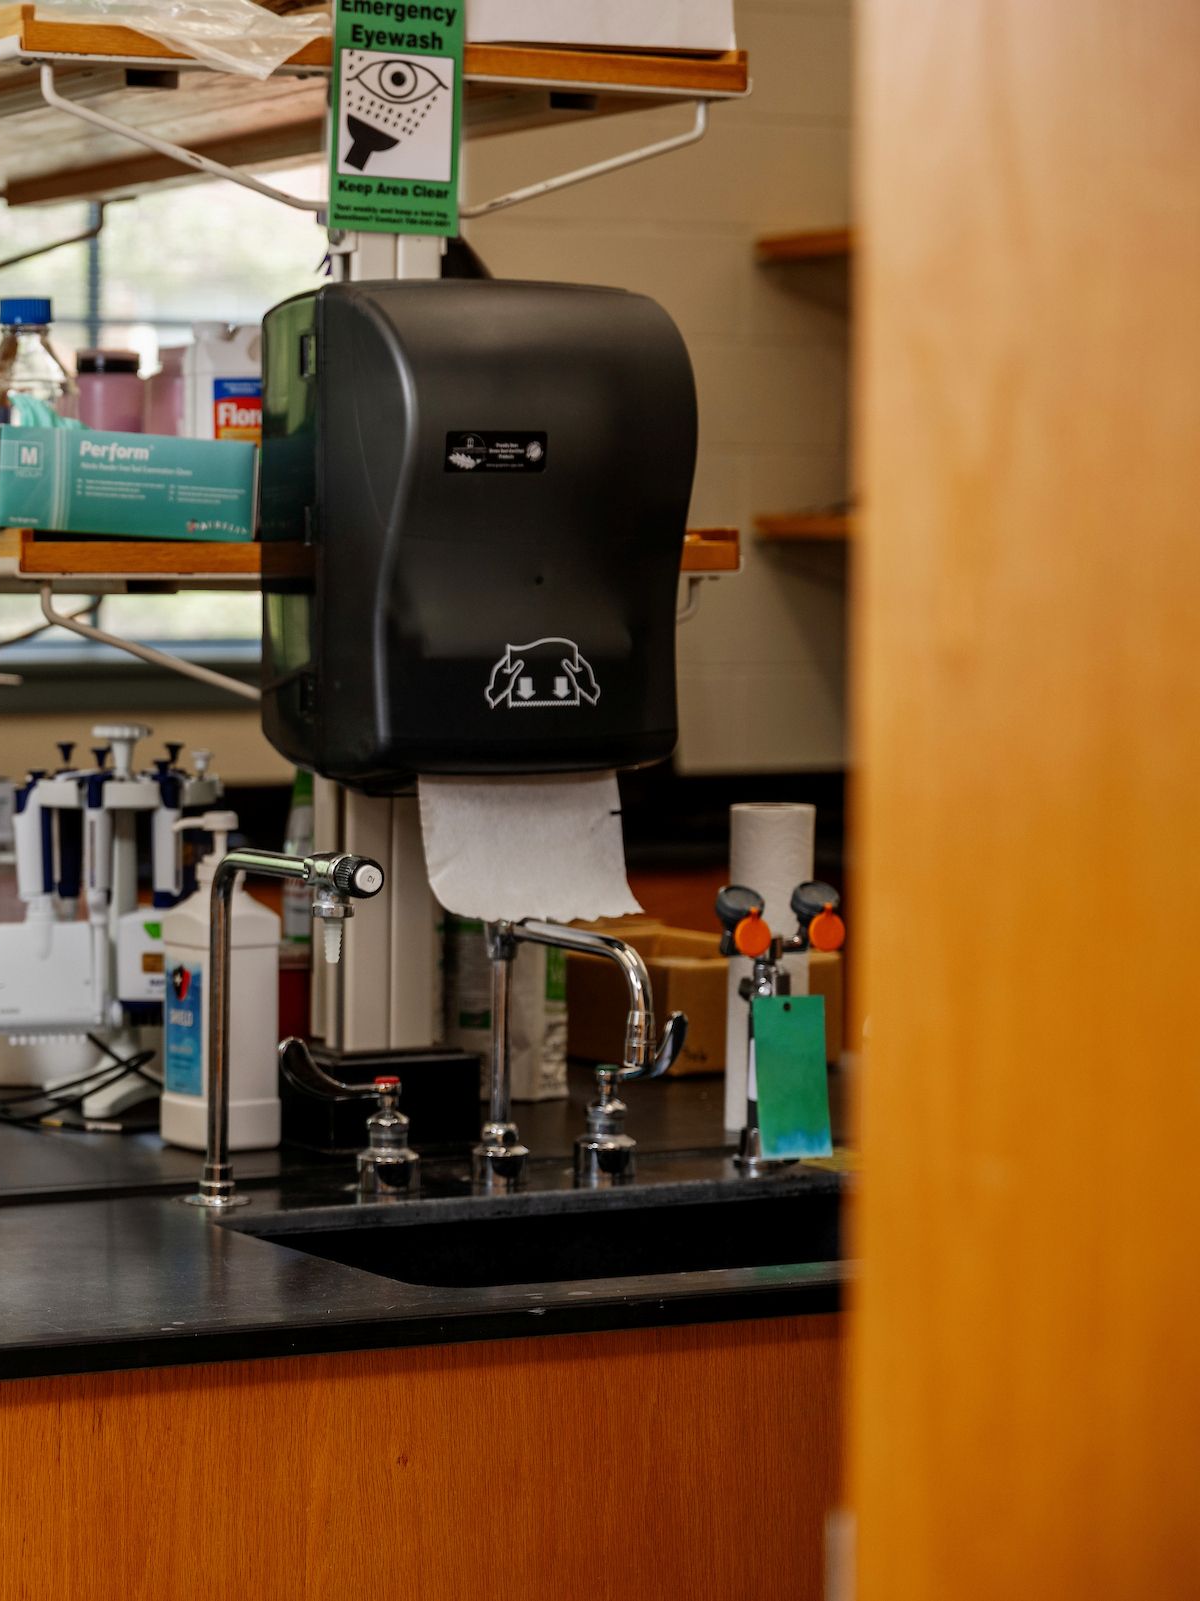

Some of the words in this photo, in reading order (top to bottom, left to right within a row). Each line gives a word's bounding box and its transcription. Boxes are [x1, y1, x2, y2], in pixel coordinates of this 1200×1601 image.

[341, 0, 456, 27] Emergency
[351, 24, 443, 50] Eyewash
[338, 180, 372, 196] Keep
[377, 182, 408, 196] Area
[413, 185, 449, 199] Clear
[218, 402, 262, 427] Flor
[20, 446, 38, 465] M
[80, 440, 150, 462] Perform
